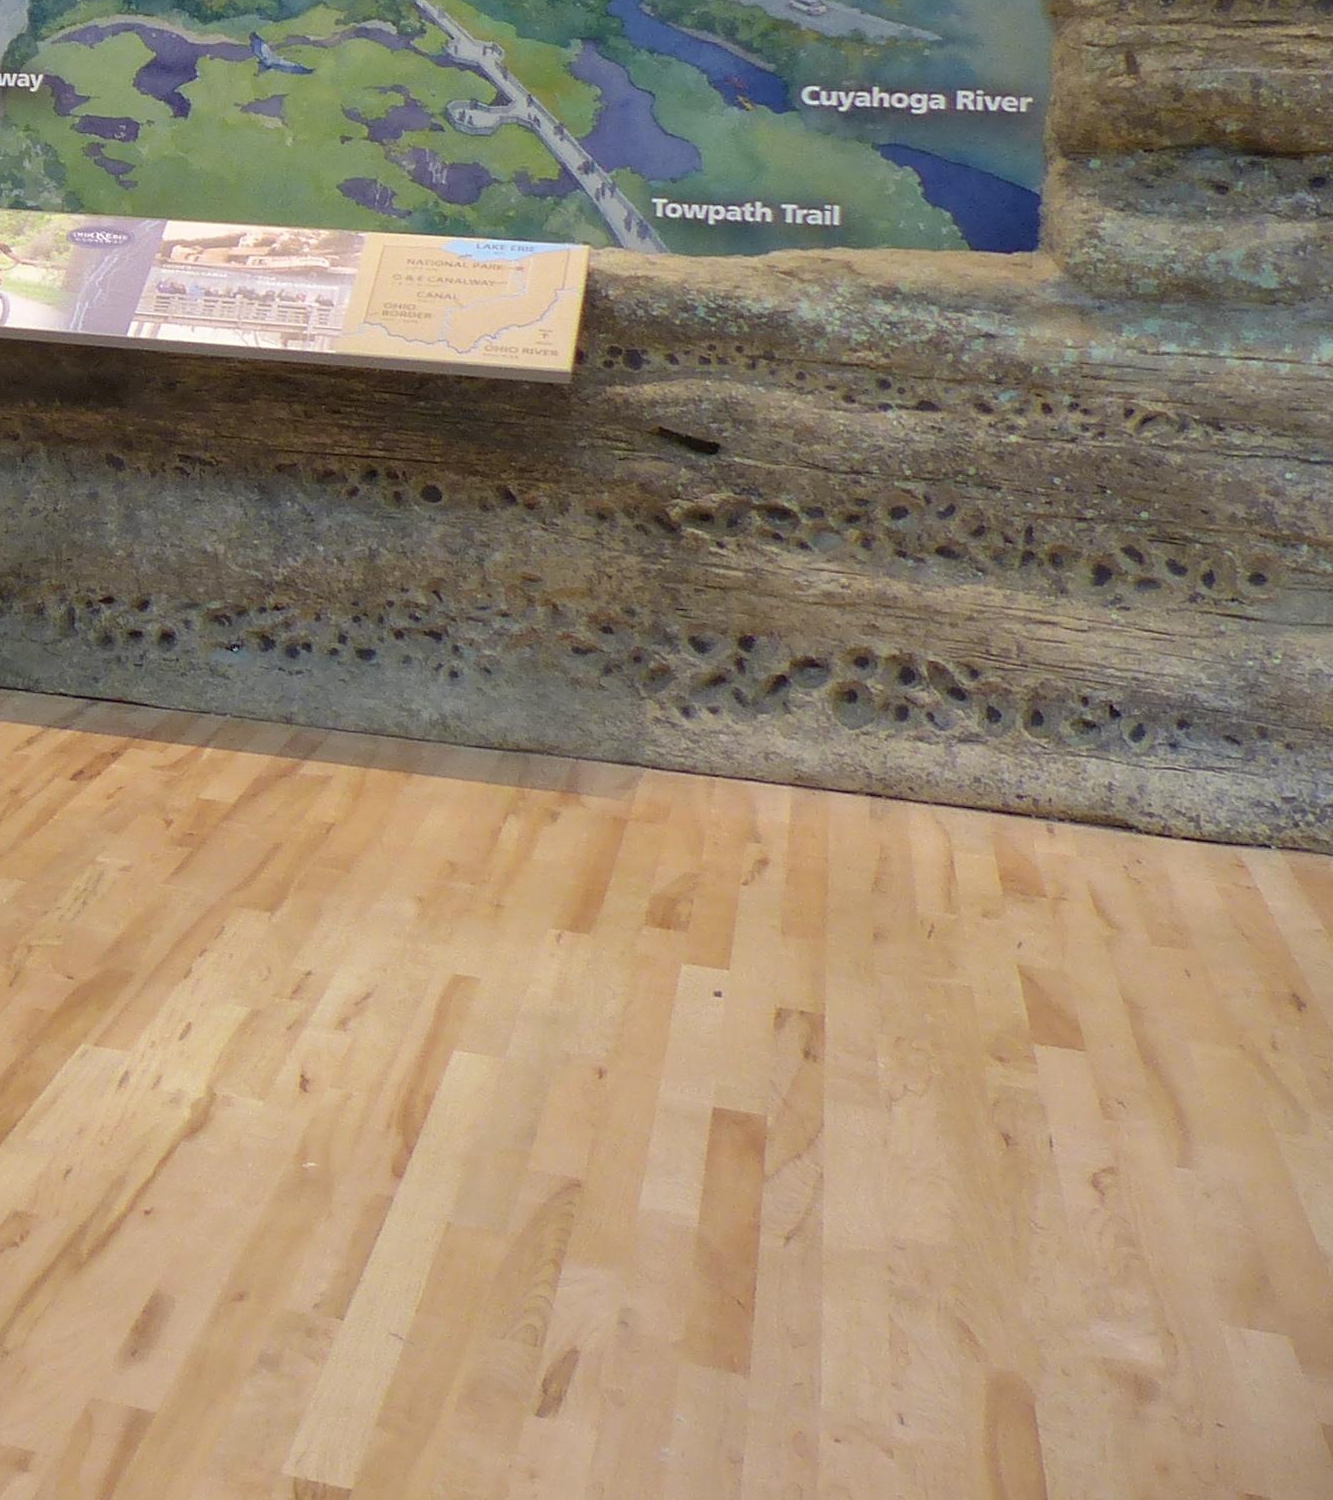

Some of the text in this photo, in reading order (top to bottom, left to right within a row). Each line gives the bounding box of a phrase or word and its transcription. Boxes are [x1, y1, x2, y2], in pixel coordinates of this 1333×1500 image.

[800, 85, 1033, 115] Cuyahoga River
[651, 197, 841, 227] Towpath Trail
[476, 243, 505, 251] LAKE
[406, 258, 469, 269] NATIONAL
[427, 275, 495, 287] CANALWAY
[417, 290, 459, 300] CANAL
[384, 301, 416, 310] OHIO
[381, 309, 432, 319] BORDER
[484, 344, 520, 354] OHIO
[521, 347, 558, 357] RIVER
